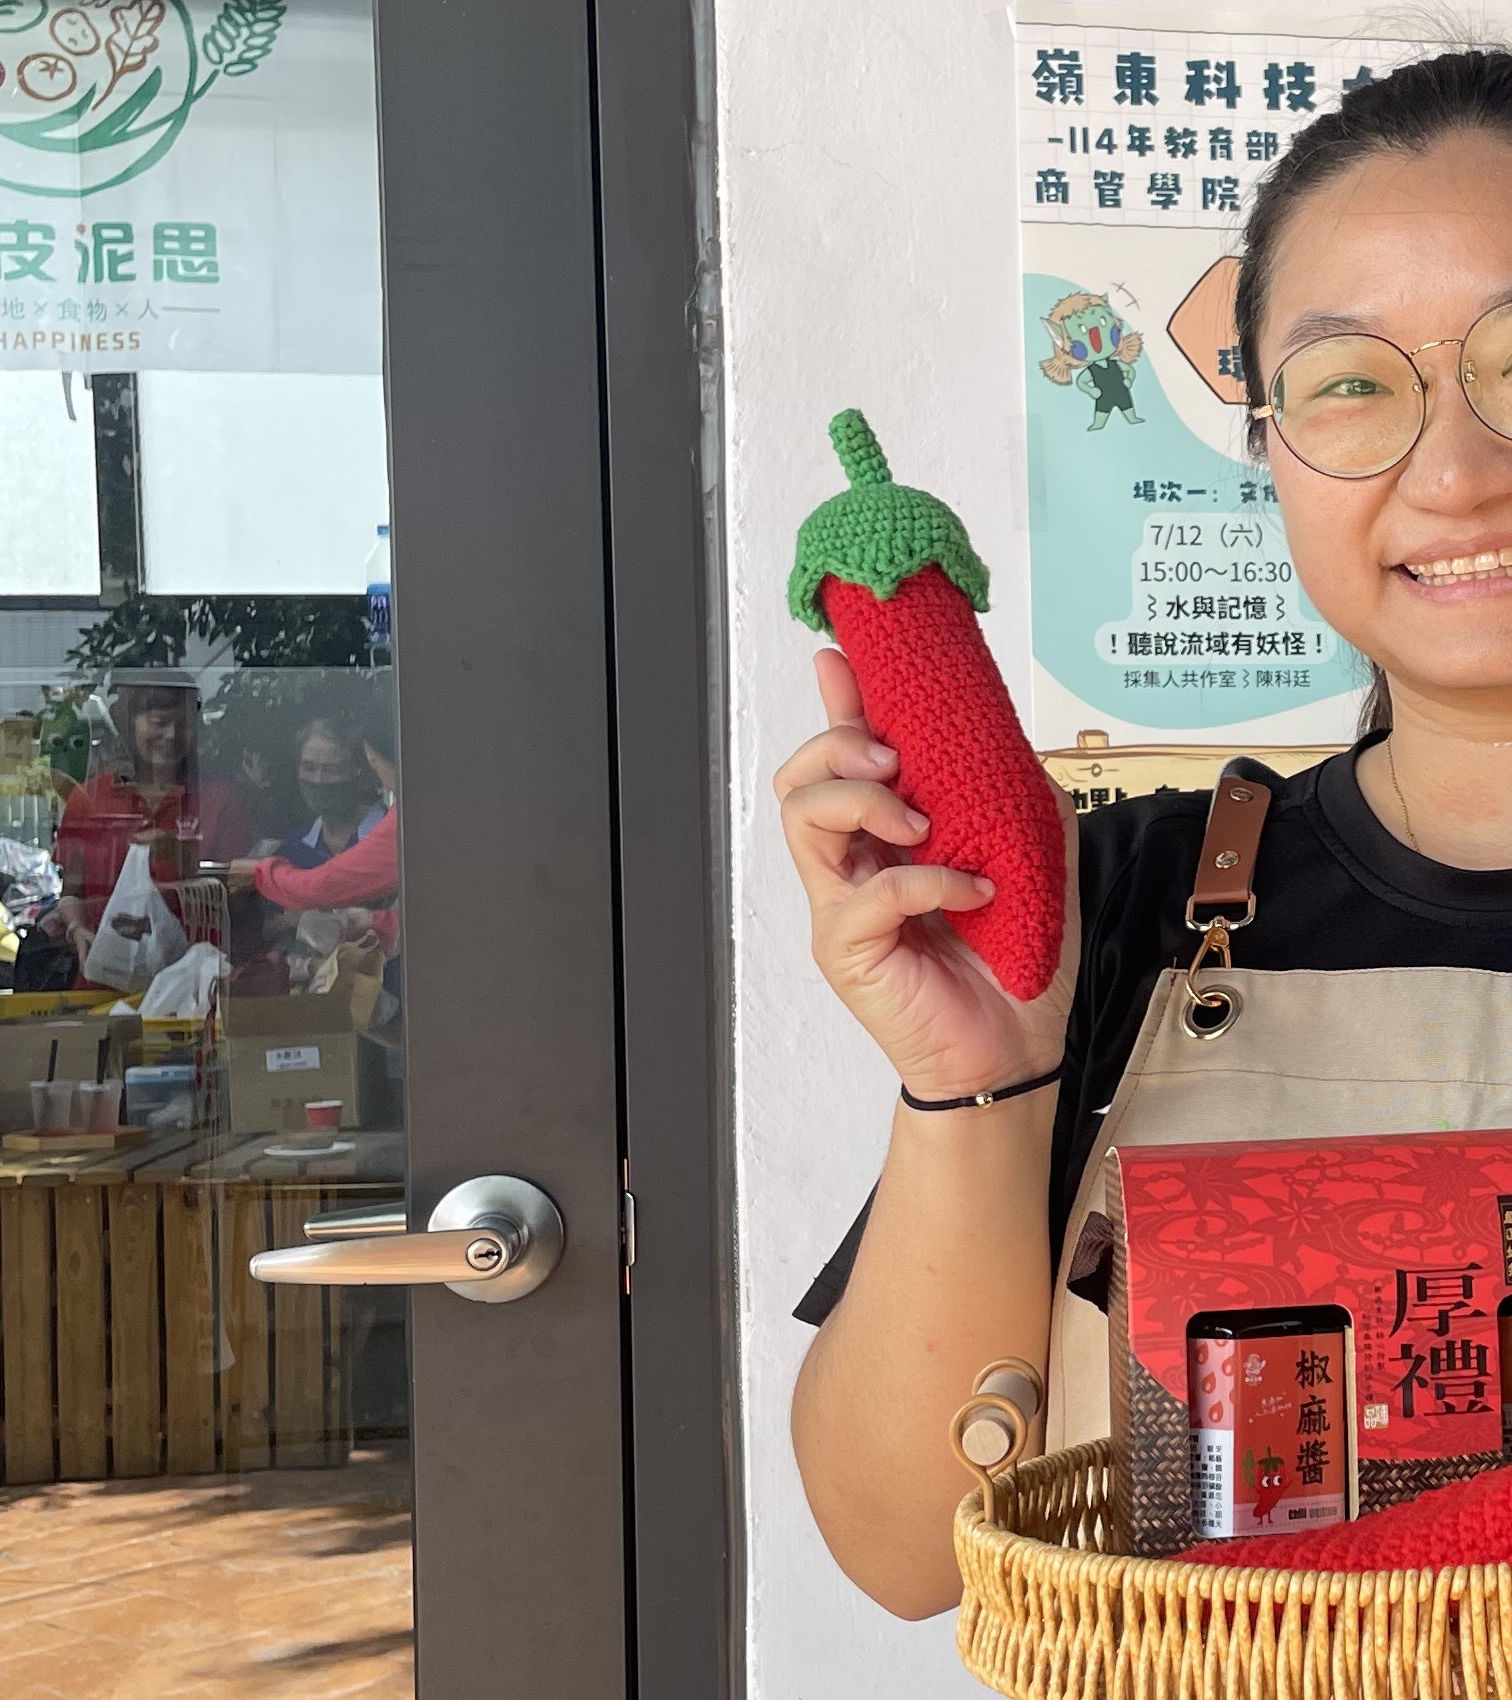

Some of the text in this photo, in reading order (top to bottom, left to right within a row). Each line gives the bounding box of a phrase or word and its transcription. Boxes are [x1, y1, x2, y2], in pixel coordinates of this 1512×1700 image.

[1032, 48, 1374, 112] 嶺東科技
[1035, 168, 1242, 212] 商管學院
[1166, 595, 1268, 621] 水與記憶
[1124, 669, 1311, 689] 採集人共作室 陳科廷
[1388, 1262, 1495, 1418] 厚禮
[1295, 1349, 1333, 1486] 椒麻醬
